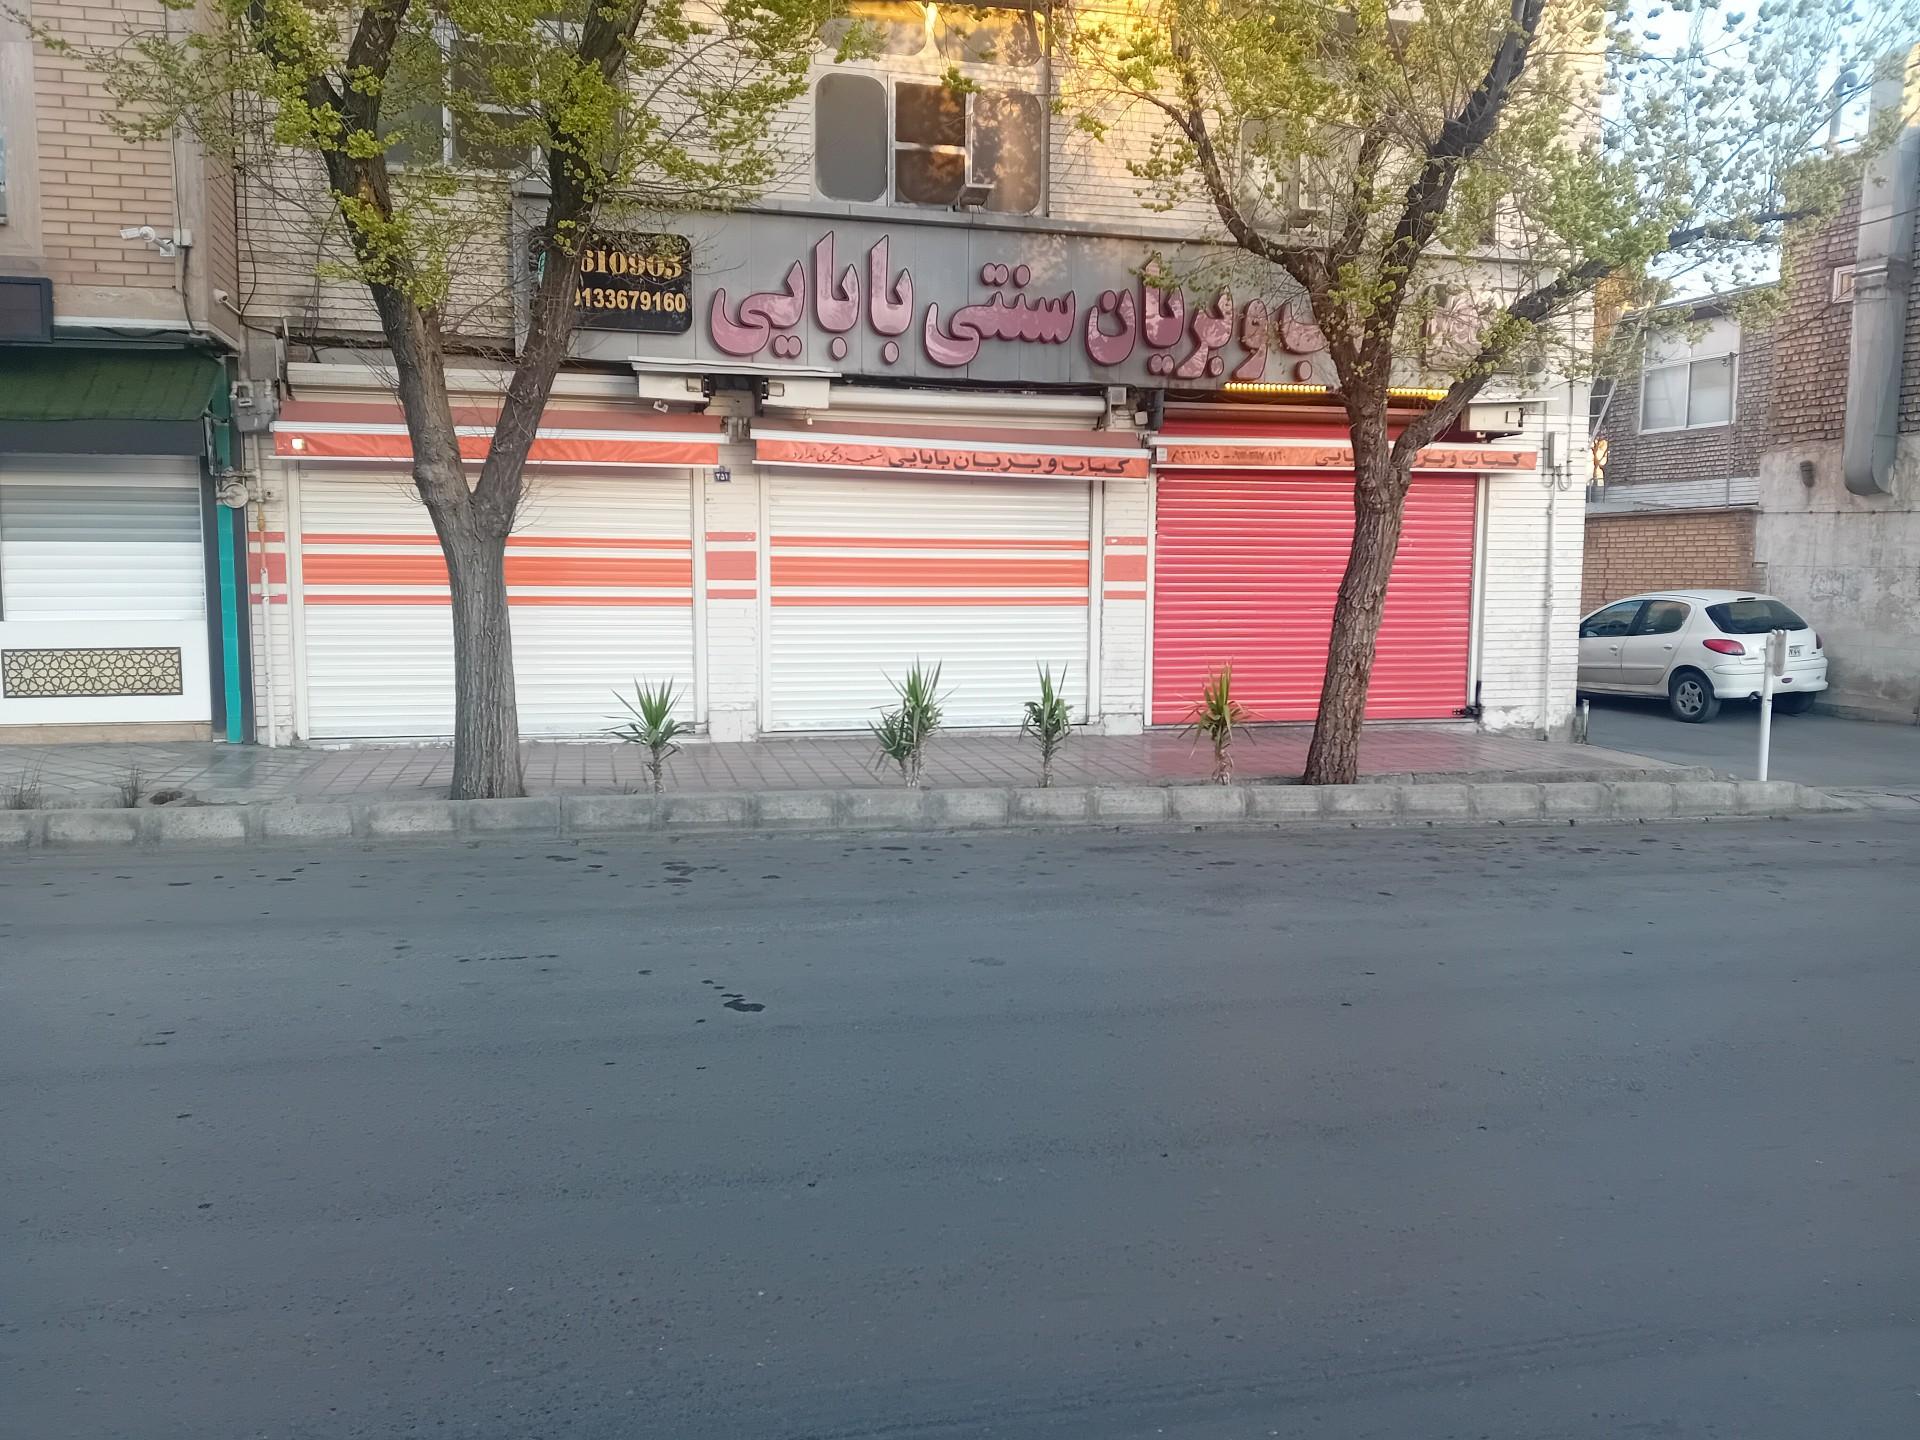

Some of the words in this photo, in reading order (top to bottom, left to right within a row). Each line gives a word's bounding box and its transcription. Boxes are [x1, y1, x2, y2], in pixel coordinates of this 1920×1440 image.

[579, 248, 683, 280] 610905
[573, 286, 687, 314] 133679160
[709, 229, 915, 366] بابایی
[922, 261, 1077, 368] سنتی
[887, 448, 951, 471] بابایی
[953, 452, 1041, 473] بریان
[1042, 456, 1058, 474] و
[1061, 456, 1130, 476] کباب
[1315, 448, 1355, 467] بایی
[1461, 452, 1522, 469] کباب
